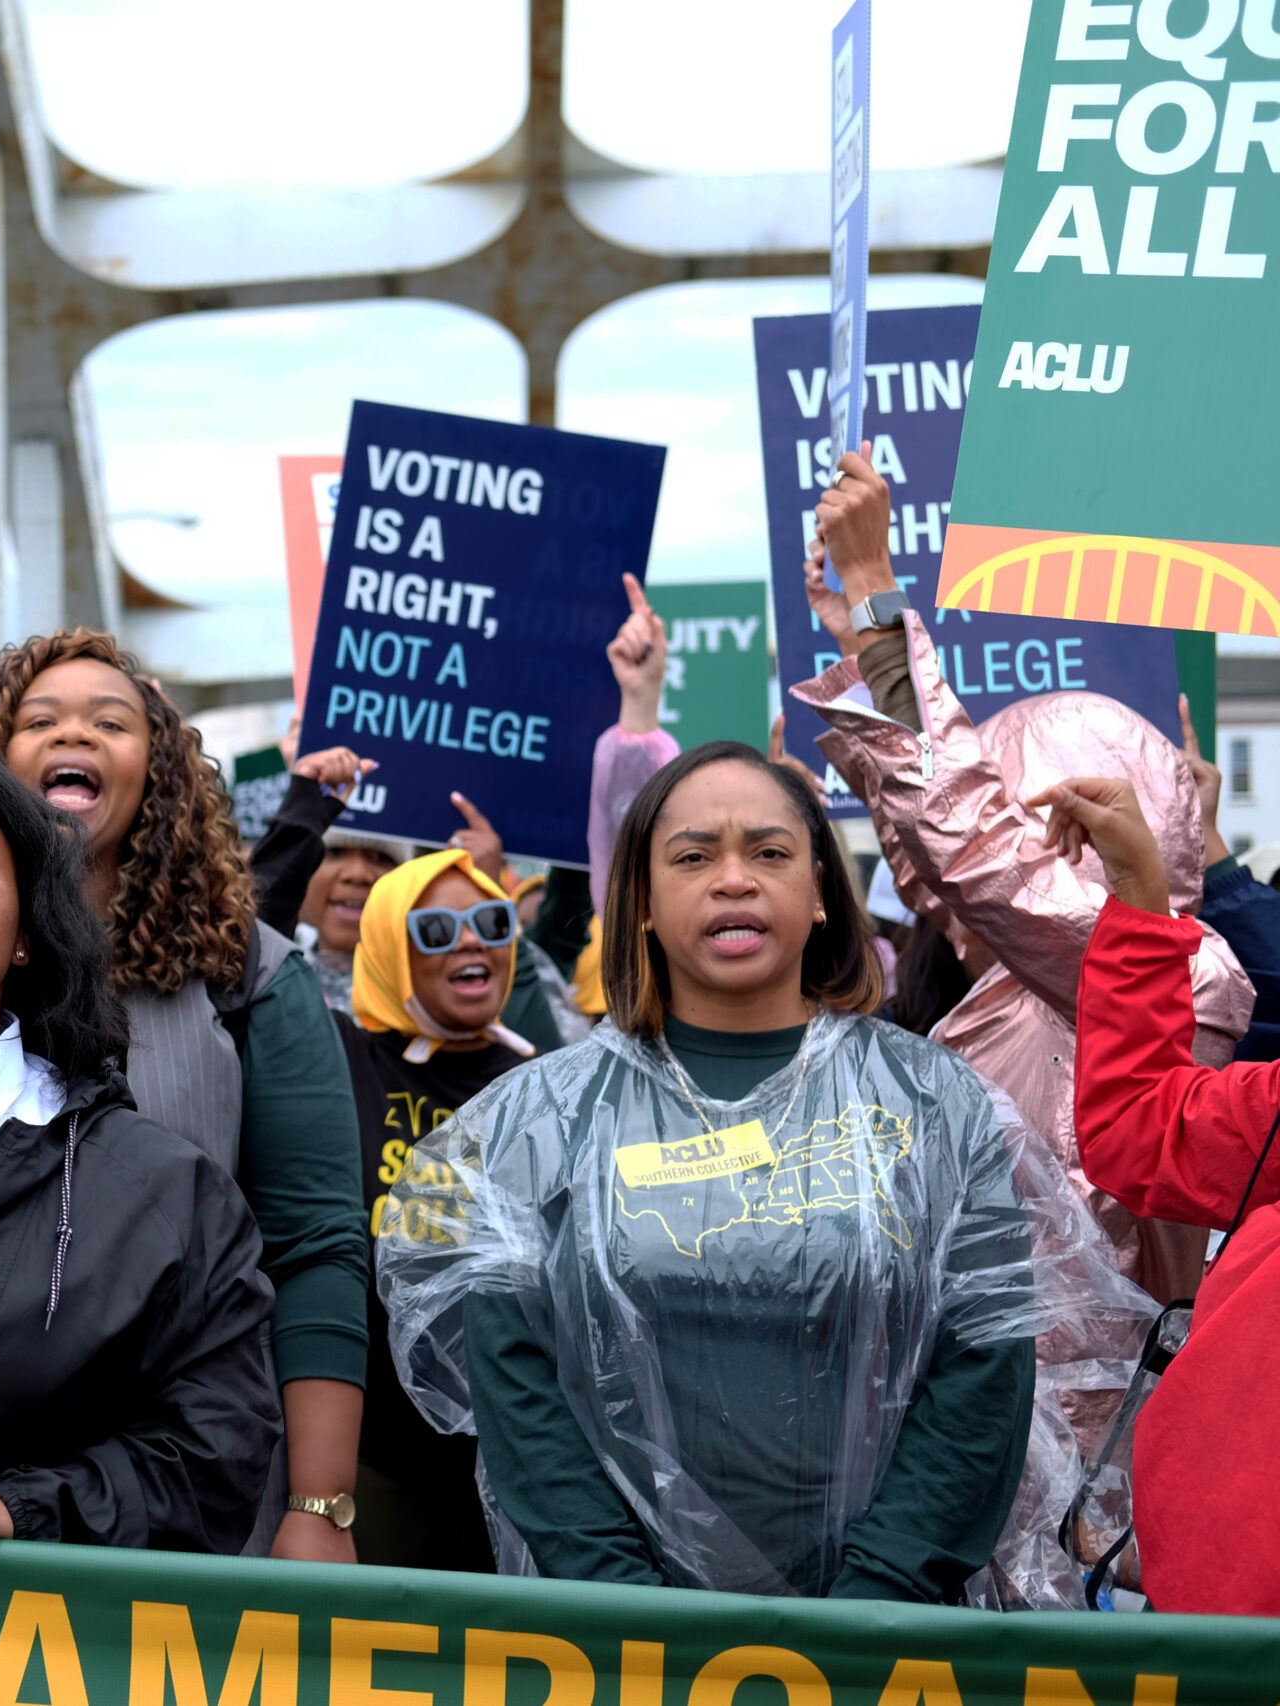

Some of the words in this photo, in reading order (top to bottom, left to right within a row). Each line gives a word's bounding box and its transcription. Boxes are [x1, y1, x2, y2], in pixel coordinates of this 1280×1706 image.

[1037, 80, 1280, 176] FOR
[1013, 185, 1267, 279] ALL
[787, 359, 974, 419] VTIN
[998, 341, 1130, 394] ACLU
[367, 444, 544, 516] VOTING
[870, 433, 908, 484] A
[354, 506, 404, 554] IS
[408, 515, 445, 562] A
[344, 565, 499, 640] RIGHT,
[335, 625, 431, 681] NOT
[435, 642, 468, 689] A
[325, 685, 551, 762] PRIVILEGE
[660, 1137, 726, 1166] ACLU
[800, 1152, 813, 1162] TN
[813, 1135, 826, 1144] KY
[634, 1165, 695, 1182] SOUTHERN
[696, 1151, 763, 1175] COLLECTIVE
[745, 1176, 759, 1186] AR
[810, 1177, 823, 1186] AL
[682, 1197, 695, 1207] TX
[753, 1202, 766, 1212] LA
